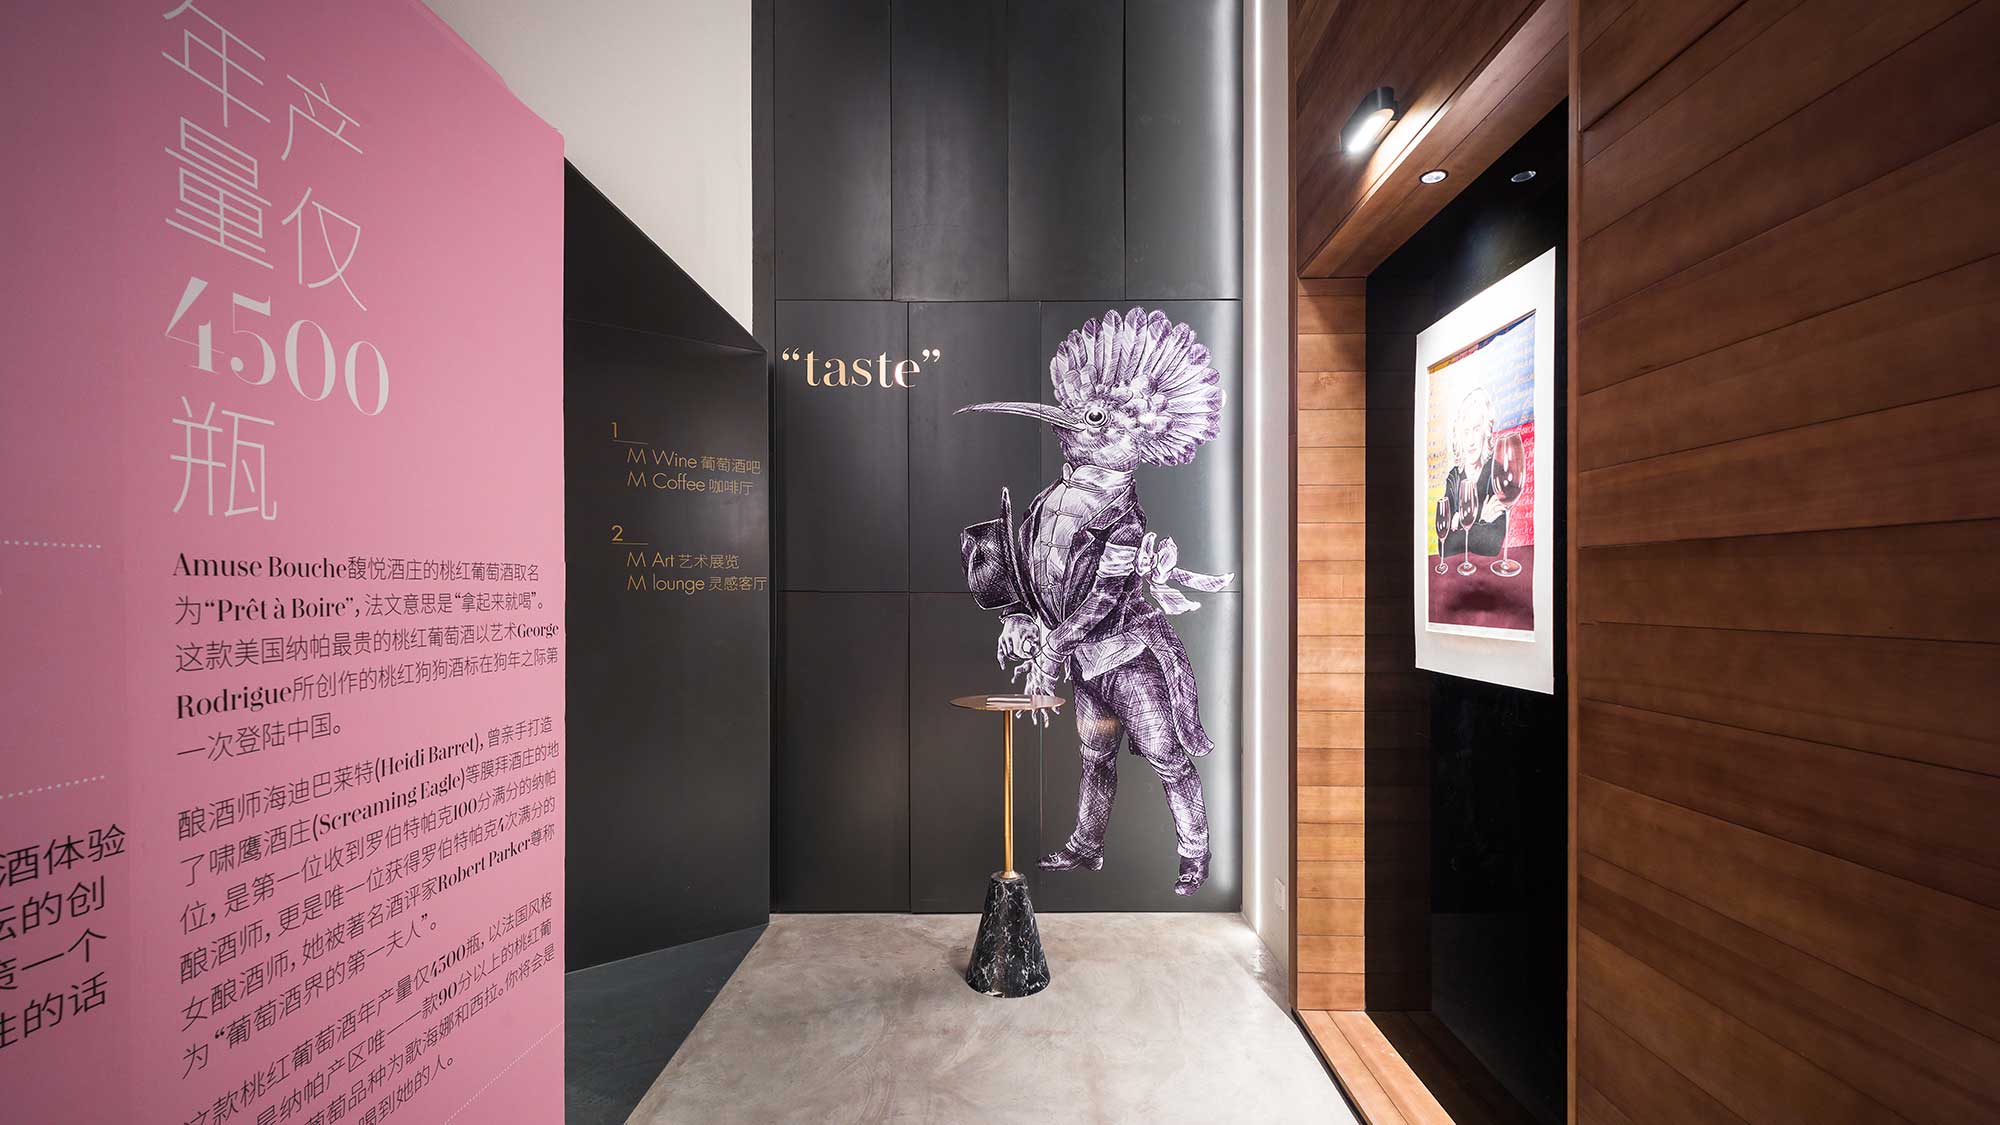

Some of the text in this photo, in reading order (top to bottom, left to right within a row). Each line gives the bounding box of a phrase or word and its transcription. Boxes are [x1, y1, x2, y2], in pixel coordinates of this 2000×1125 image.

[165, 276, 390, 417] 4500
[782, 347, 941, 388] “taste”
[611, 421, 618, 439] 1
[170, 396, 277, 521] 瓶
[627, 448, 762, 475] M Wine 葡萄酒吧
[627, 471, 753, 496] M Coffee 咖啡厅
[611, 524, 624, 542] 2
[173, 552, 263, 578] Amuse
[627, 552, 740, 569] M Art 艺术展览
[627, 573, 768, 595] M lounge 灵感客厅
